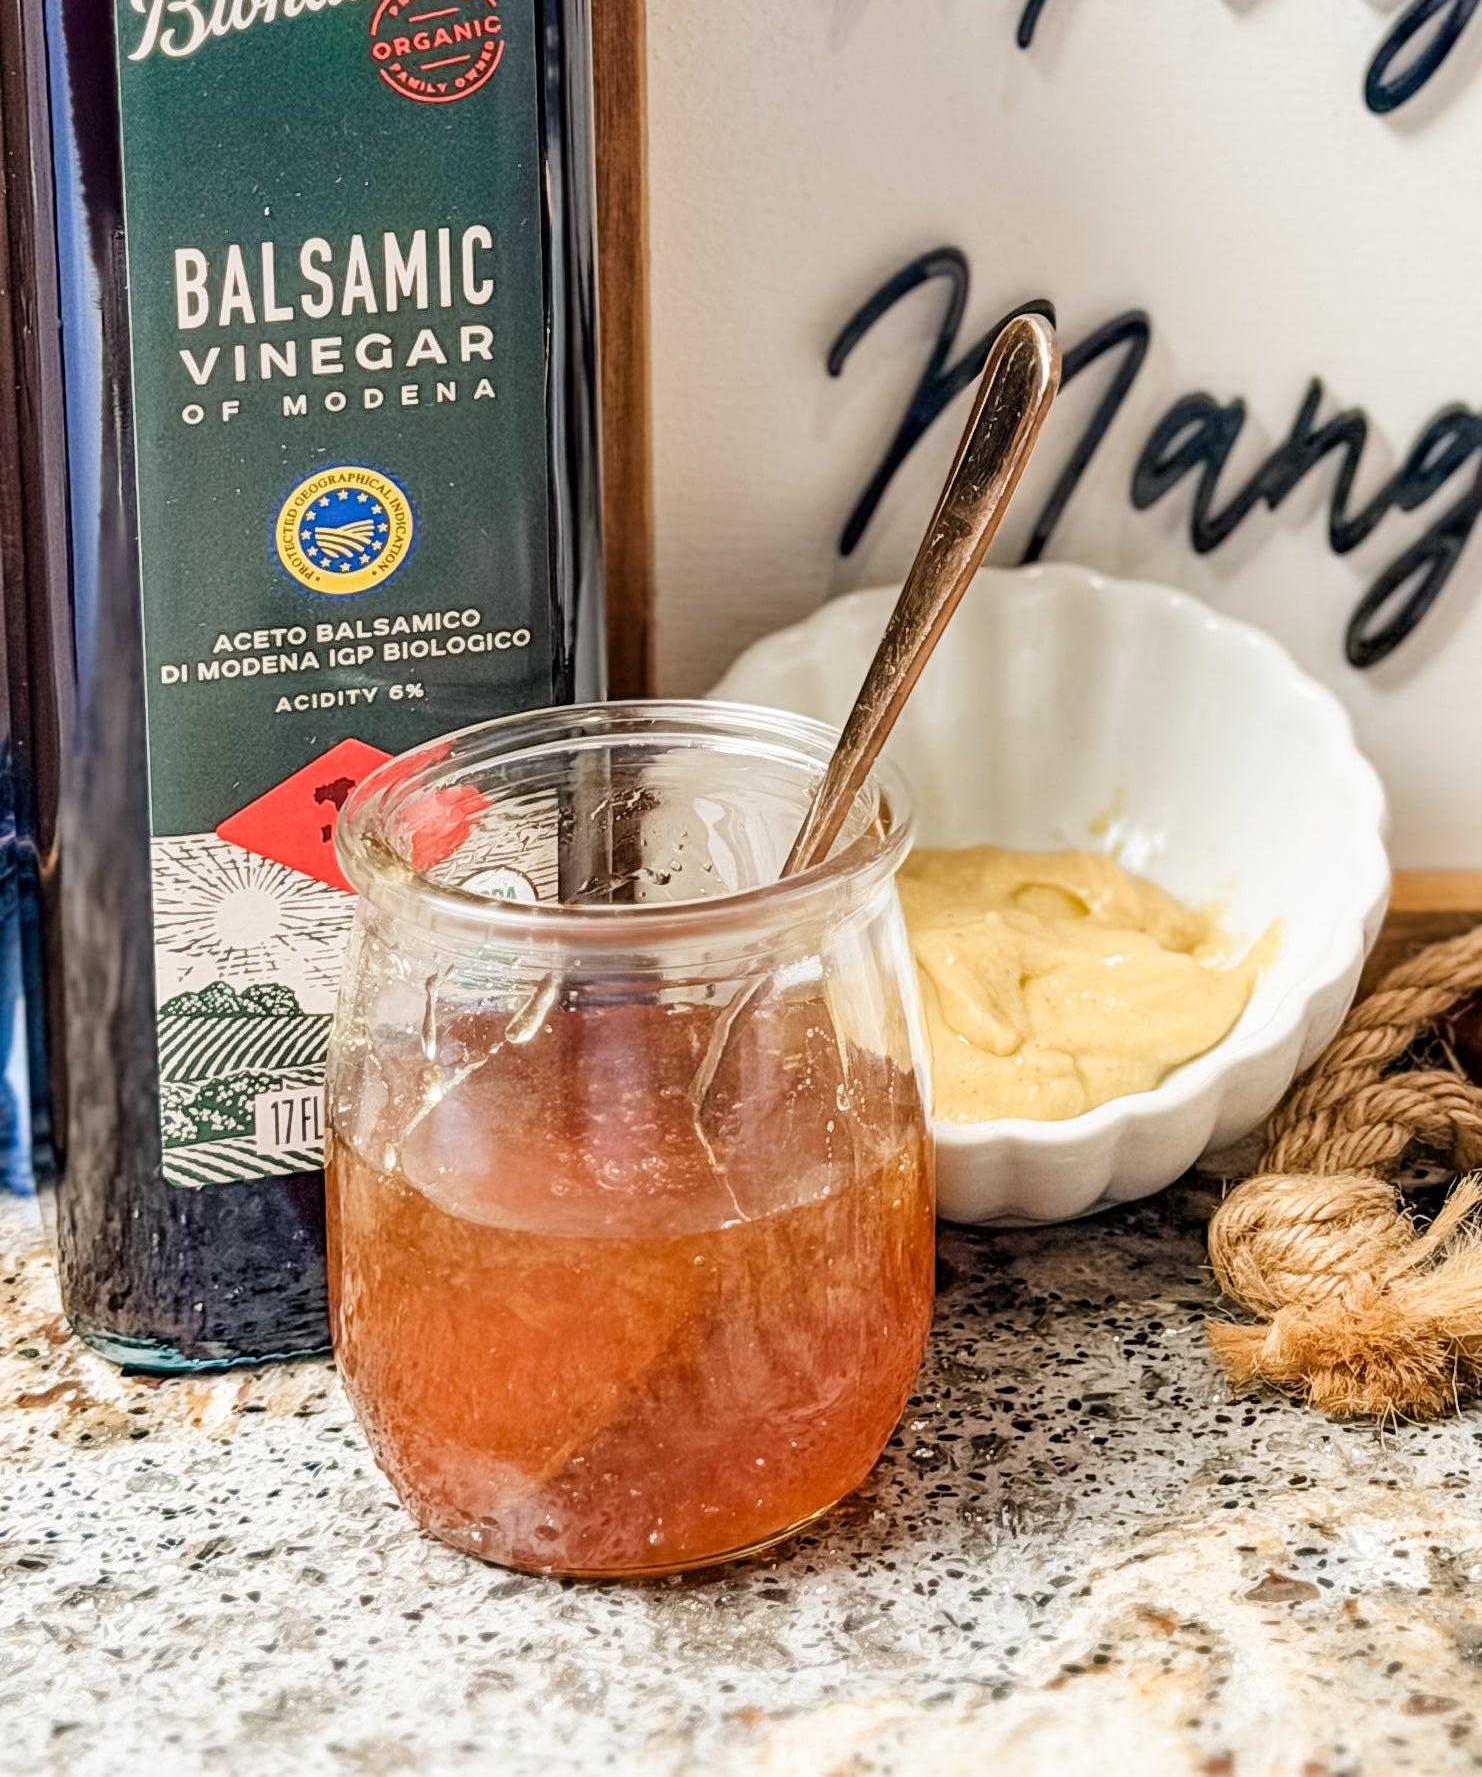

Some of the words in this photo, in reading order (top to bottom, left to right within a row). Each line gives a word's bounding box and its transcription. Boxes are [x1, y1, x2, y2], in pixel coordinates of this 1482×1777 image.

[371, 15, 502, 61] ORGANIC
[388, 62, 447, 93] FAMILY
[454, 40, 495, 88] OWNED
[174, 224, 494, 330] BALSAMIC
[179, 324, 494, 386] VINEGAR
[181, 400, 240, 425] OF
[282, 377, 496, 417] MODENA
[294, 472, 390, 507] GEOGRAPHICAL
[283, 508, 315, 580] PROTECTED
[377, 497, 407, 572] INDICATION
[160, 662, 188, 684] DI
[198, 649, 320, 681] MODENA
[329, 644, 375, 669] IGP
[383, 628, 531, 662] BIOLOGICO
[212, 626, 307, 654] ACETO
[316, 608, 481, 644] BALSAMICO
[275, 686, 378, 714] ACIDITY
[389, 682, 425, 702] 6%
[271, 1098, 294, 1146] 17
[301, 1095, 324, 1142] FL
